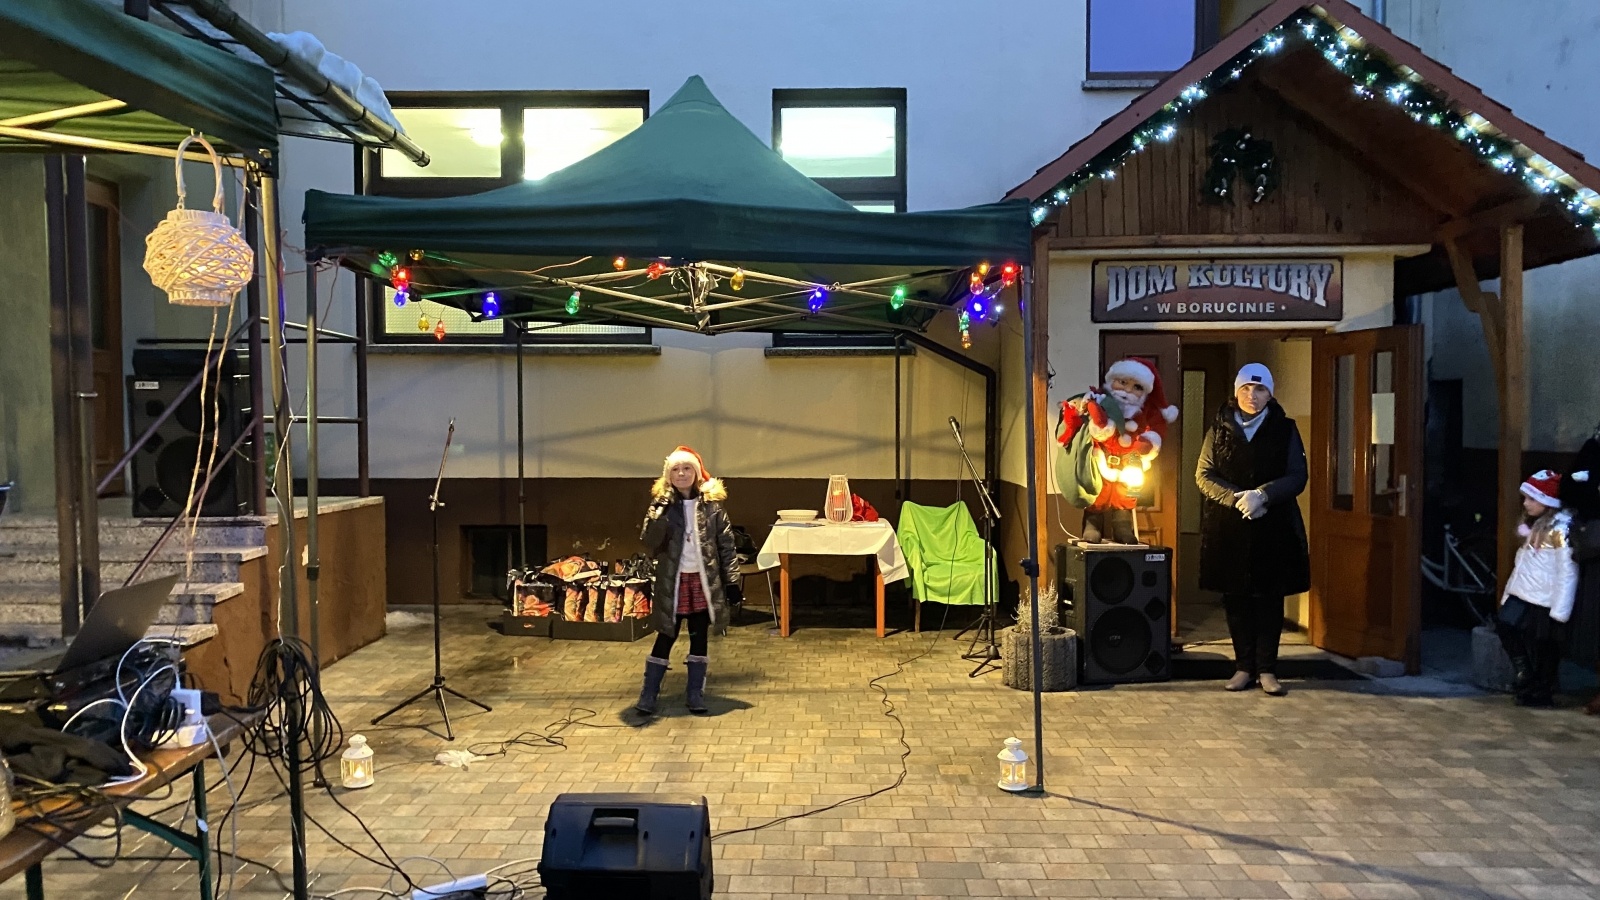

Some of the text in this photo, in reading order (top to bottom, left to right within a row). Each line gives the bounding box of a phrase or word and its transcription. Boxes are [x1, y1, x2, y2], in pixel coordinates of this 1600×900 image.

[1107, 263, 1334, 312] DOM KULTURY
[1157, 302, 1275, 314] W BORUCINIE
